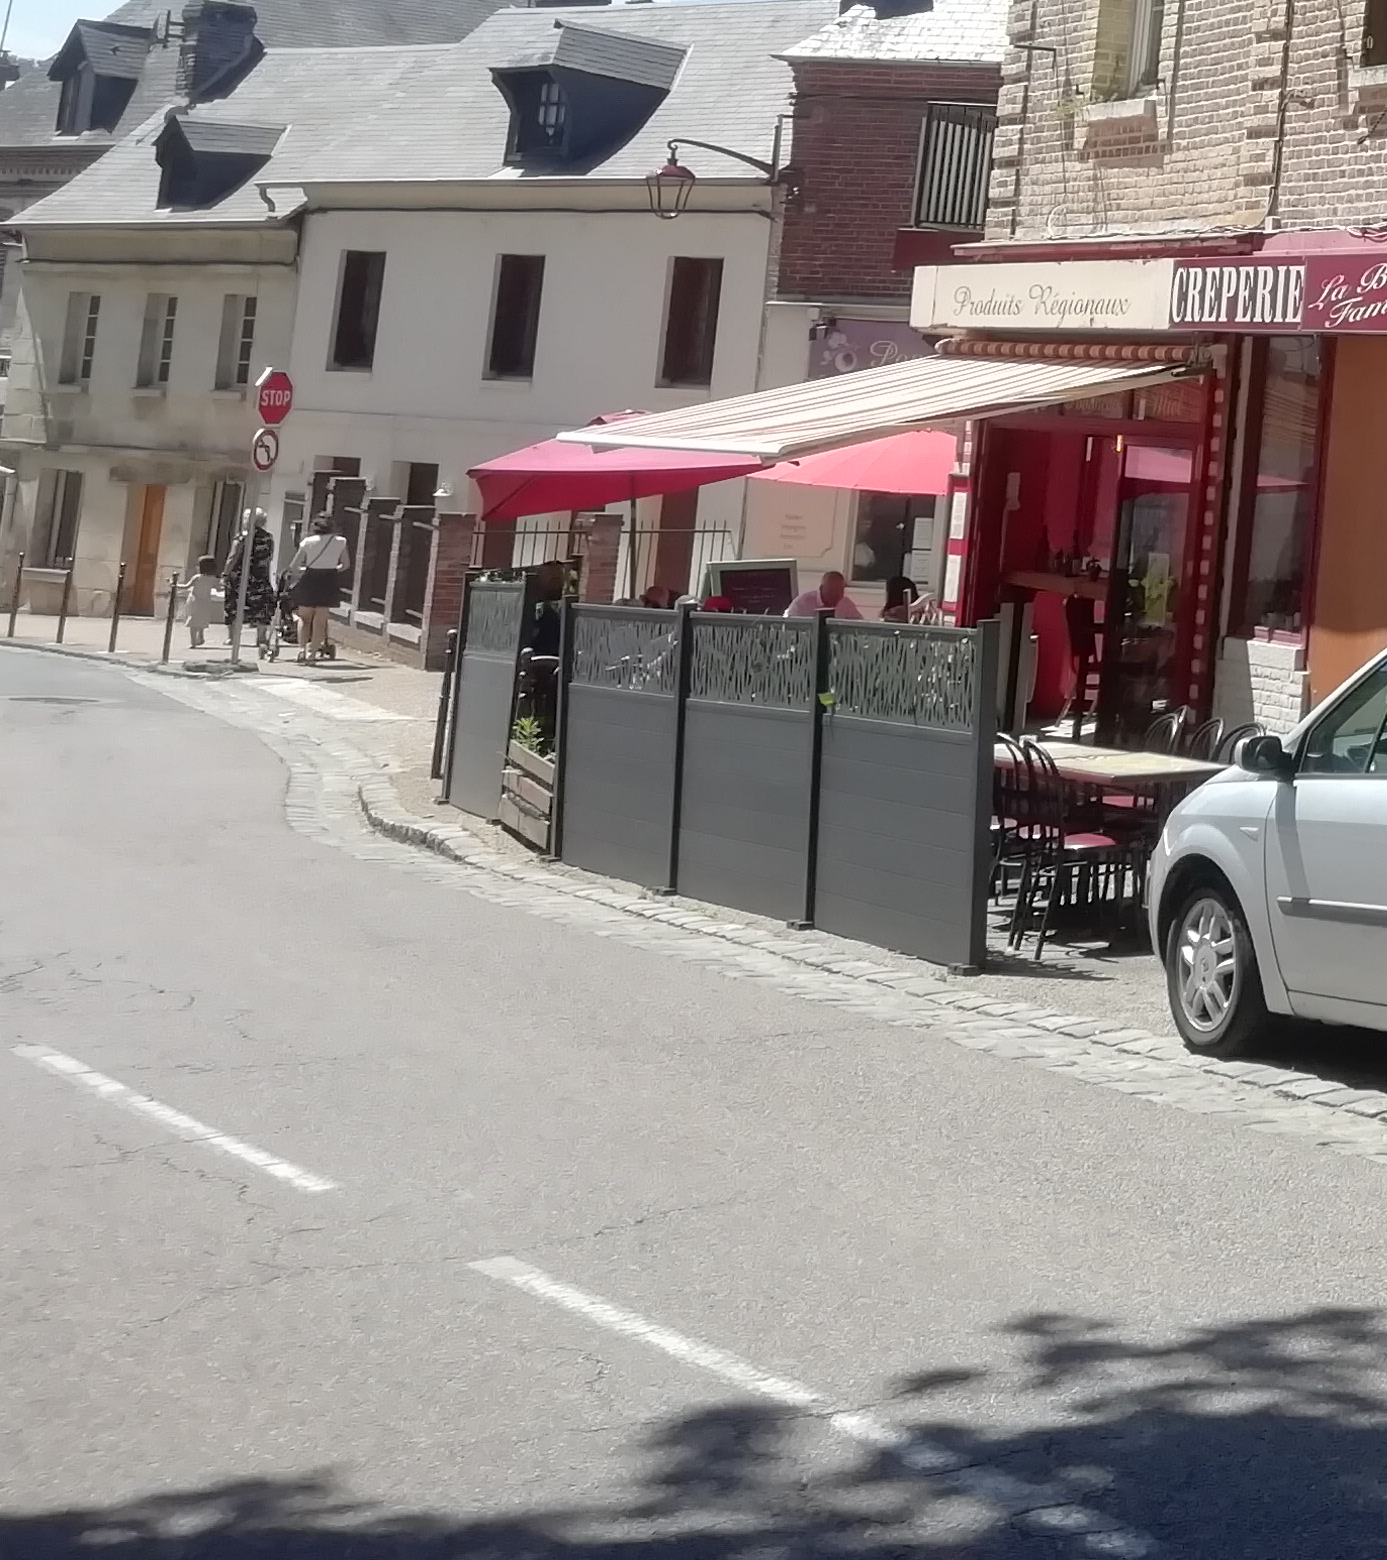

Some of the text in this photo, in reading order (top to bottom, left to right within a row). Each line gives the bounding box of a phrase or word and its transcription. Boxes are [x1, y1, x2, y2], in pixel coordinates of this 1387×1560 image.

[953, 284, 1131, 328] Produits Régionaux
[1171, 265, 1305, 323] CREPERIE
[1308, 274, 1350, 309] La
[261, 389, 291, 407] STOP
